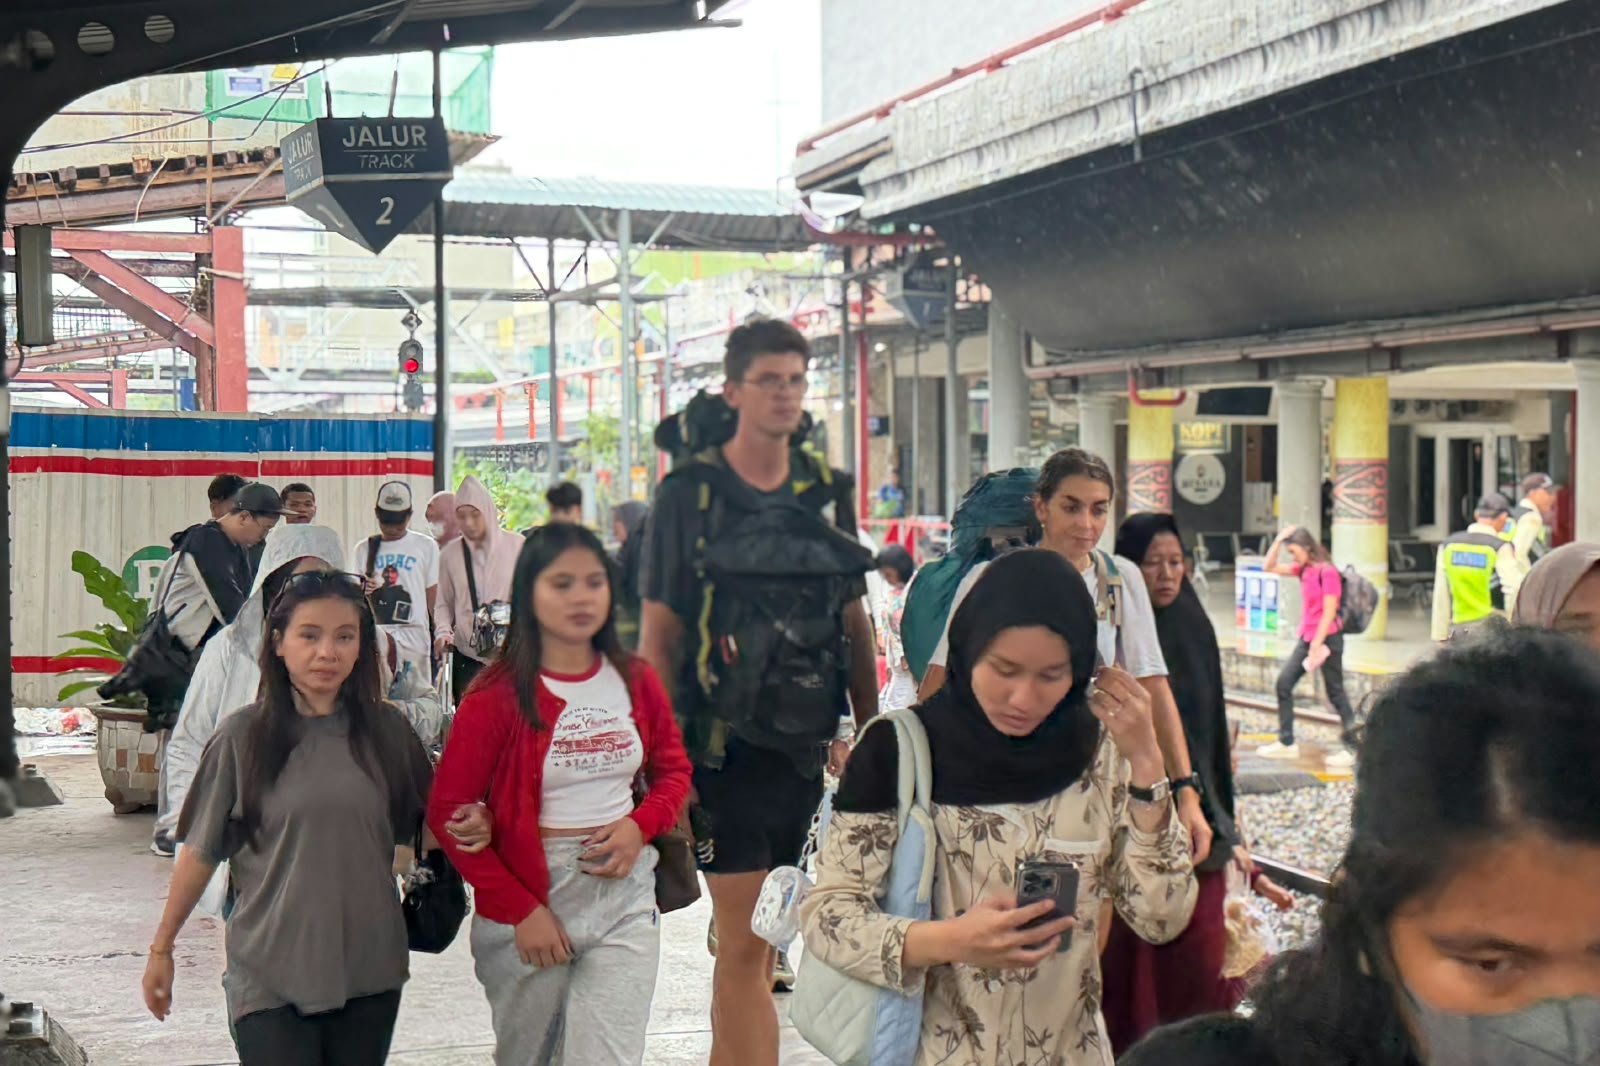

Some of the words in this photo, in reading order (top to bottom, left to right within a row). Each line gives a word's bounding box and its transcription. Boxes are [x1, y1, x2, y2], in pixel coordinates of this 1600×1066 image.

[342, 125, 428, 147] JALUR
[287, 132, 314, 165] JALUR
[357, 154, 416, 169] TRACK
[375, 196, 394, 225] 2
[374, 554, 417, 571] UPAC
